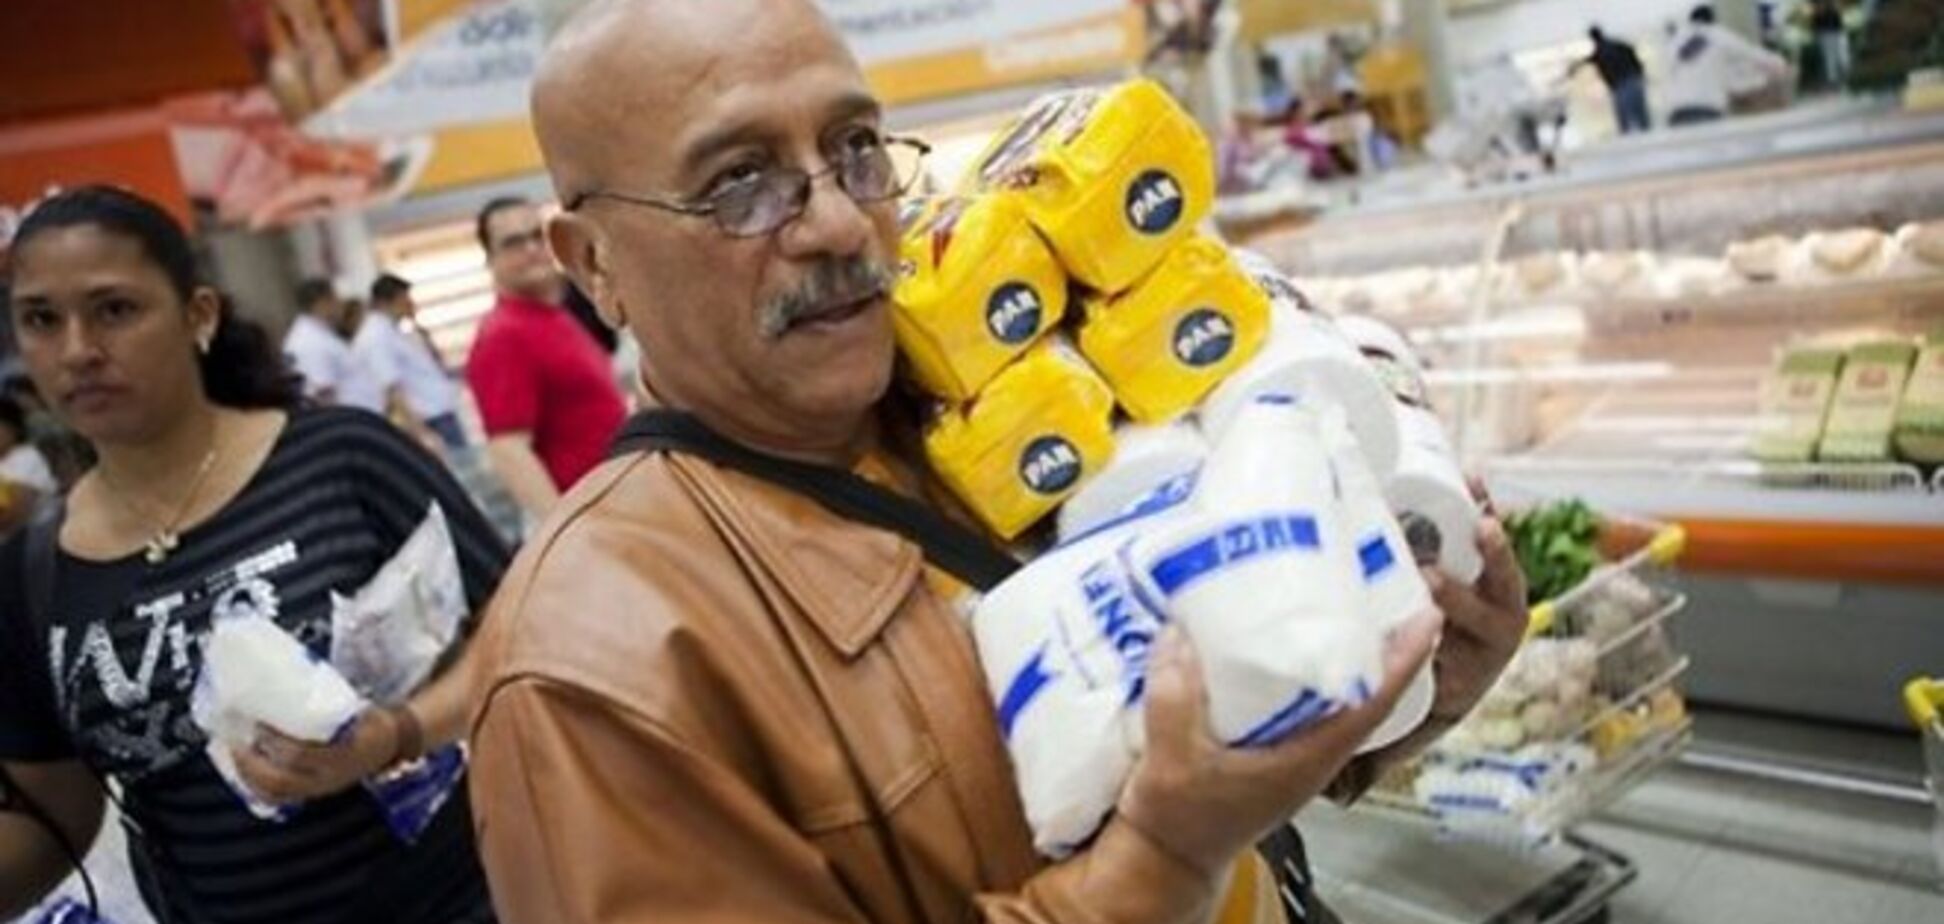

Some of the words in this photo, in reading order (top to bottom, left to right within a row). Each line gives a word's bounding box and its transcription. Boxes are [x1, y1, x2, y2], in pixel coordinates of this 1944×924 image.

[1131, 179, 1180, 226] PAN
[990, 289, 1040, 336] PAN
[1177, 316, 1230, 360] PAN
[1024, 442, 1079, 486] PAN
